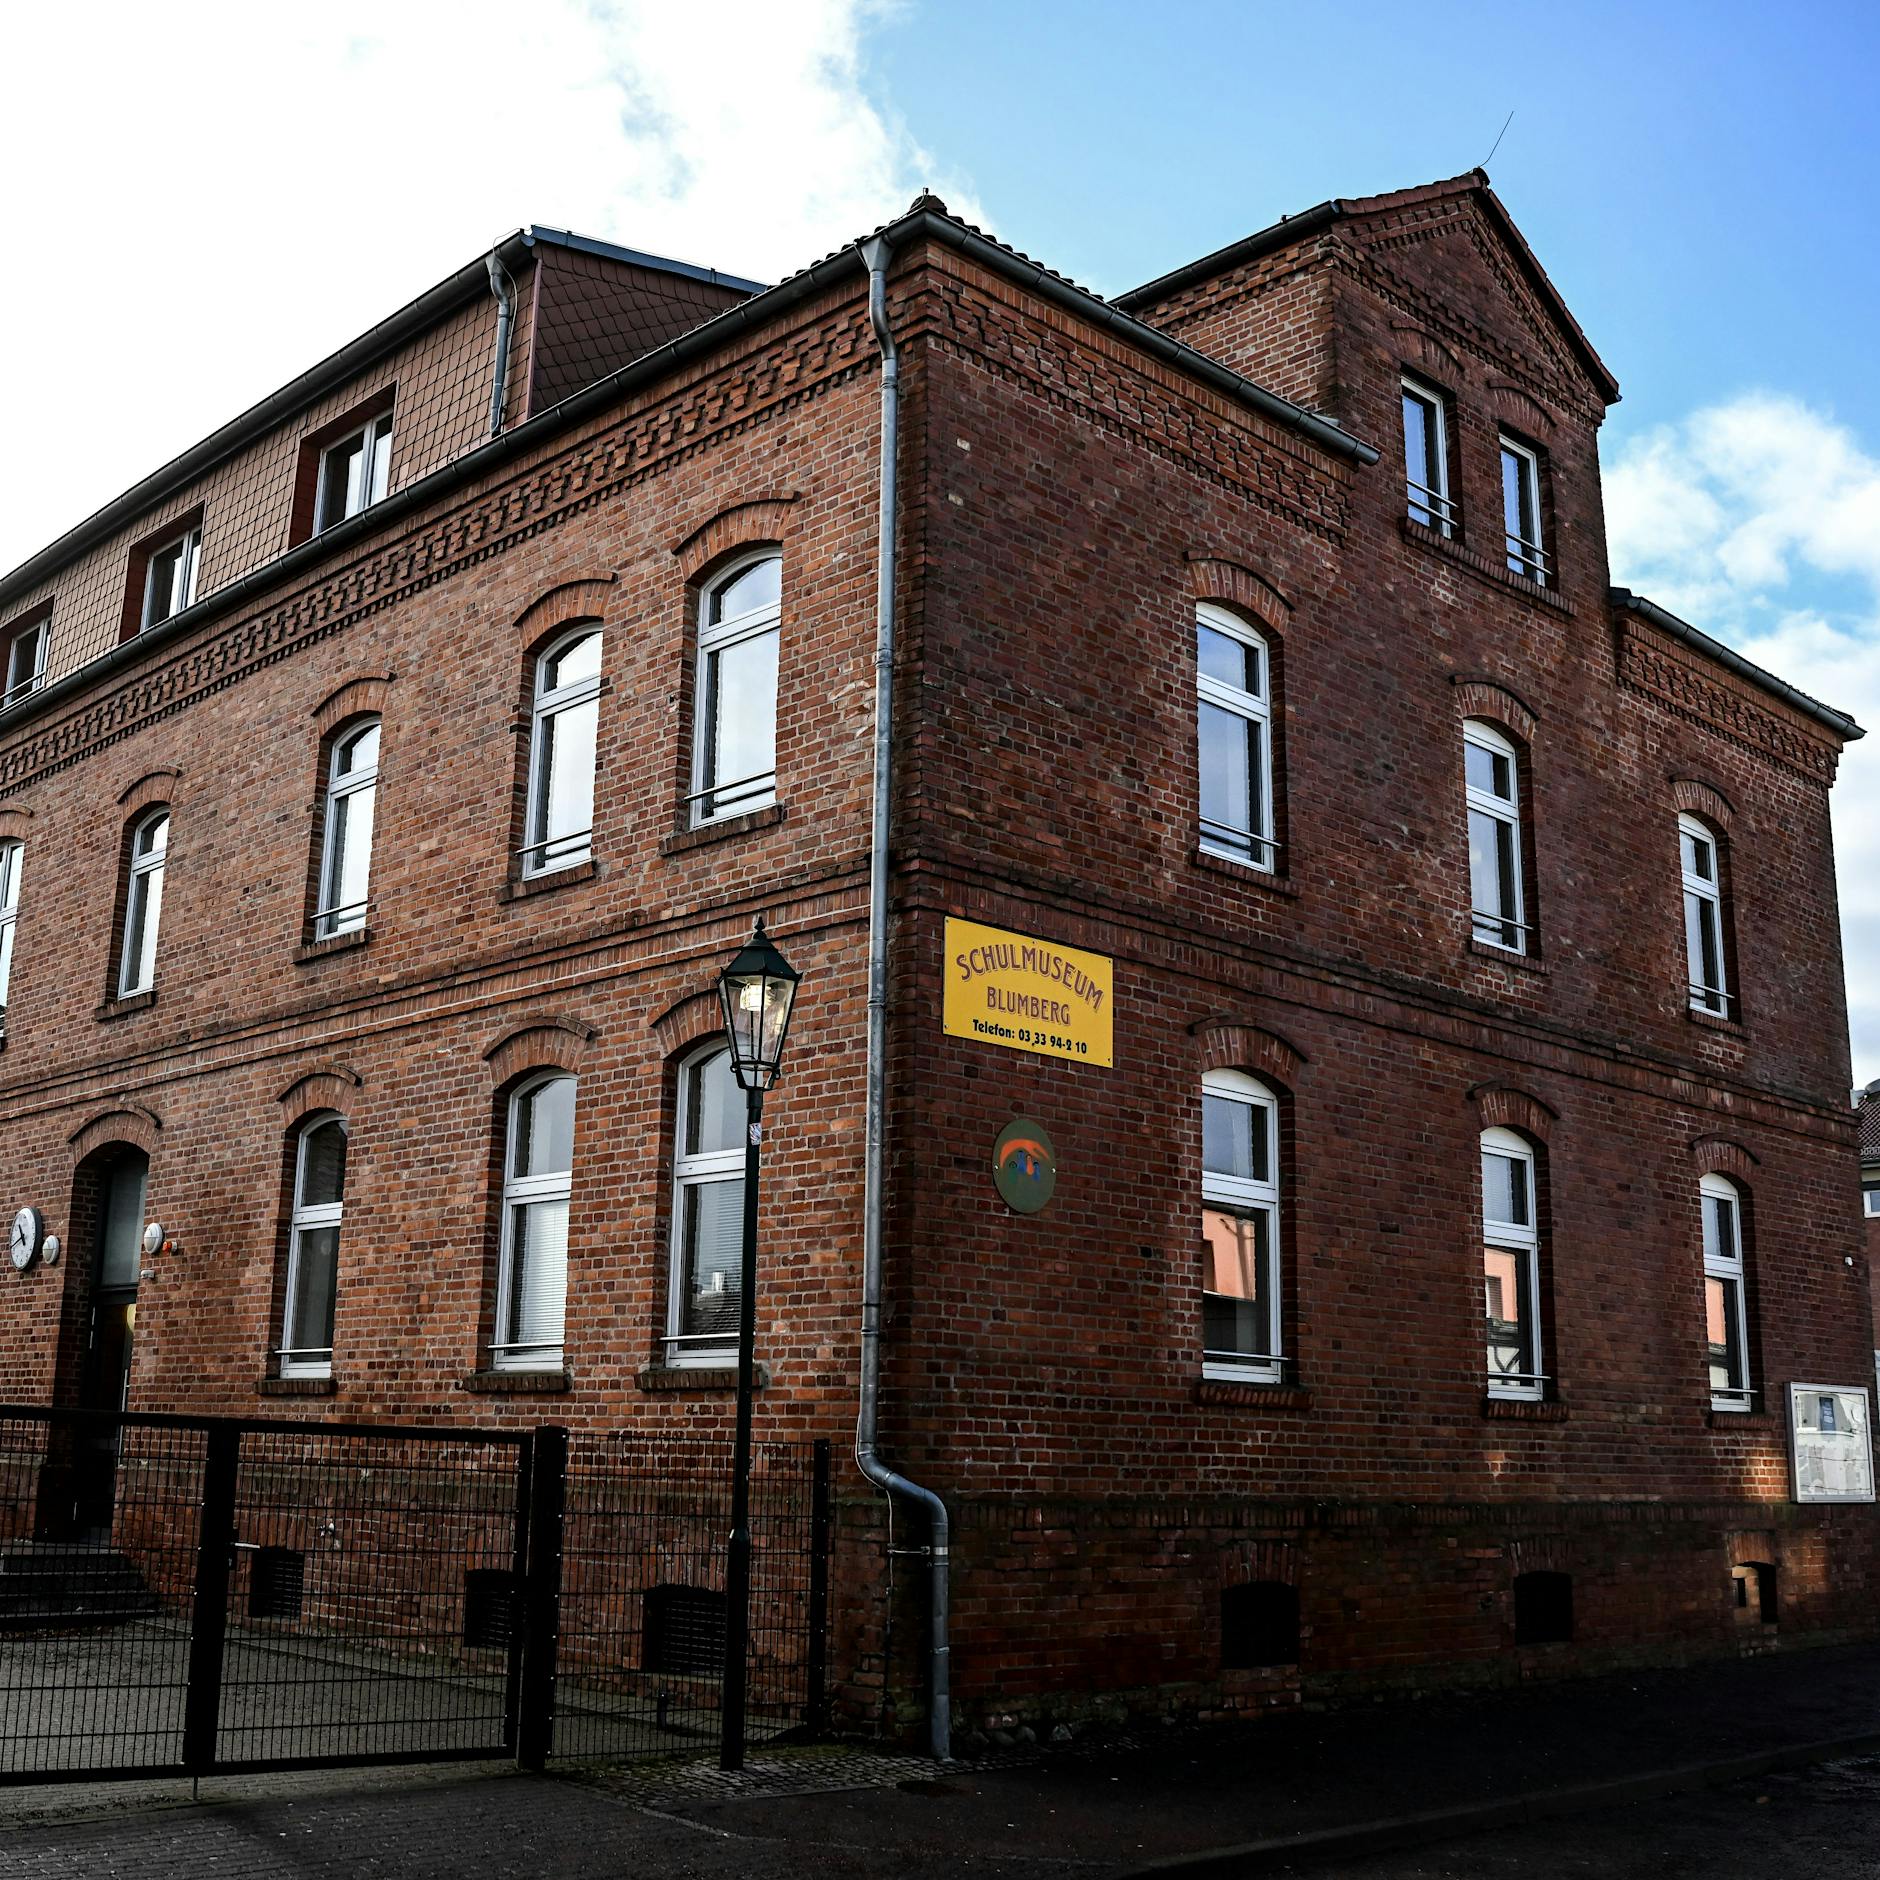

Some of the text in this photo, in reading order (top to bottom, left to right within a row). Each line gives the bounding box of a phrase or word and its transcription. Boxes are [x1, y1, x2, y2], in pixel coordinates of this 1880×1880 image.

[956, 944, 1104, 1010] SCHULMUSEUM
[987, 986, 1070, 1025] BLUMBERG
[972, 1019, 1015, 1039] Telefon:
[1049, 1035, 1072, 1051] 94-2
[1075, 1041, 1087, 1054] 10
